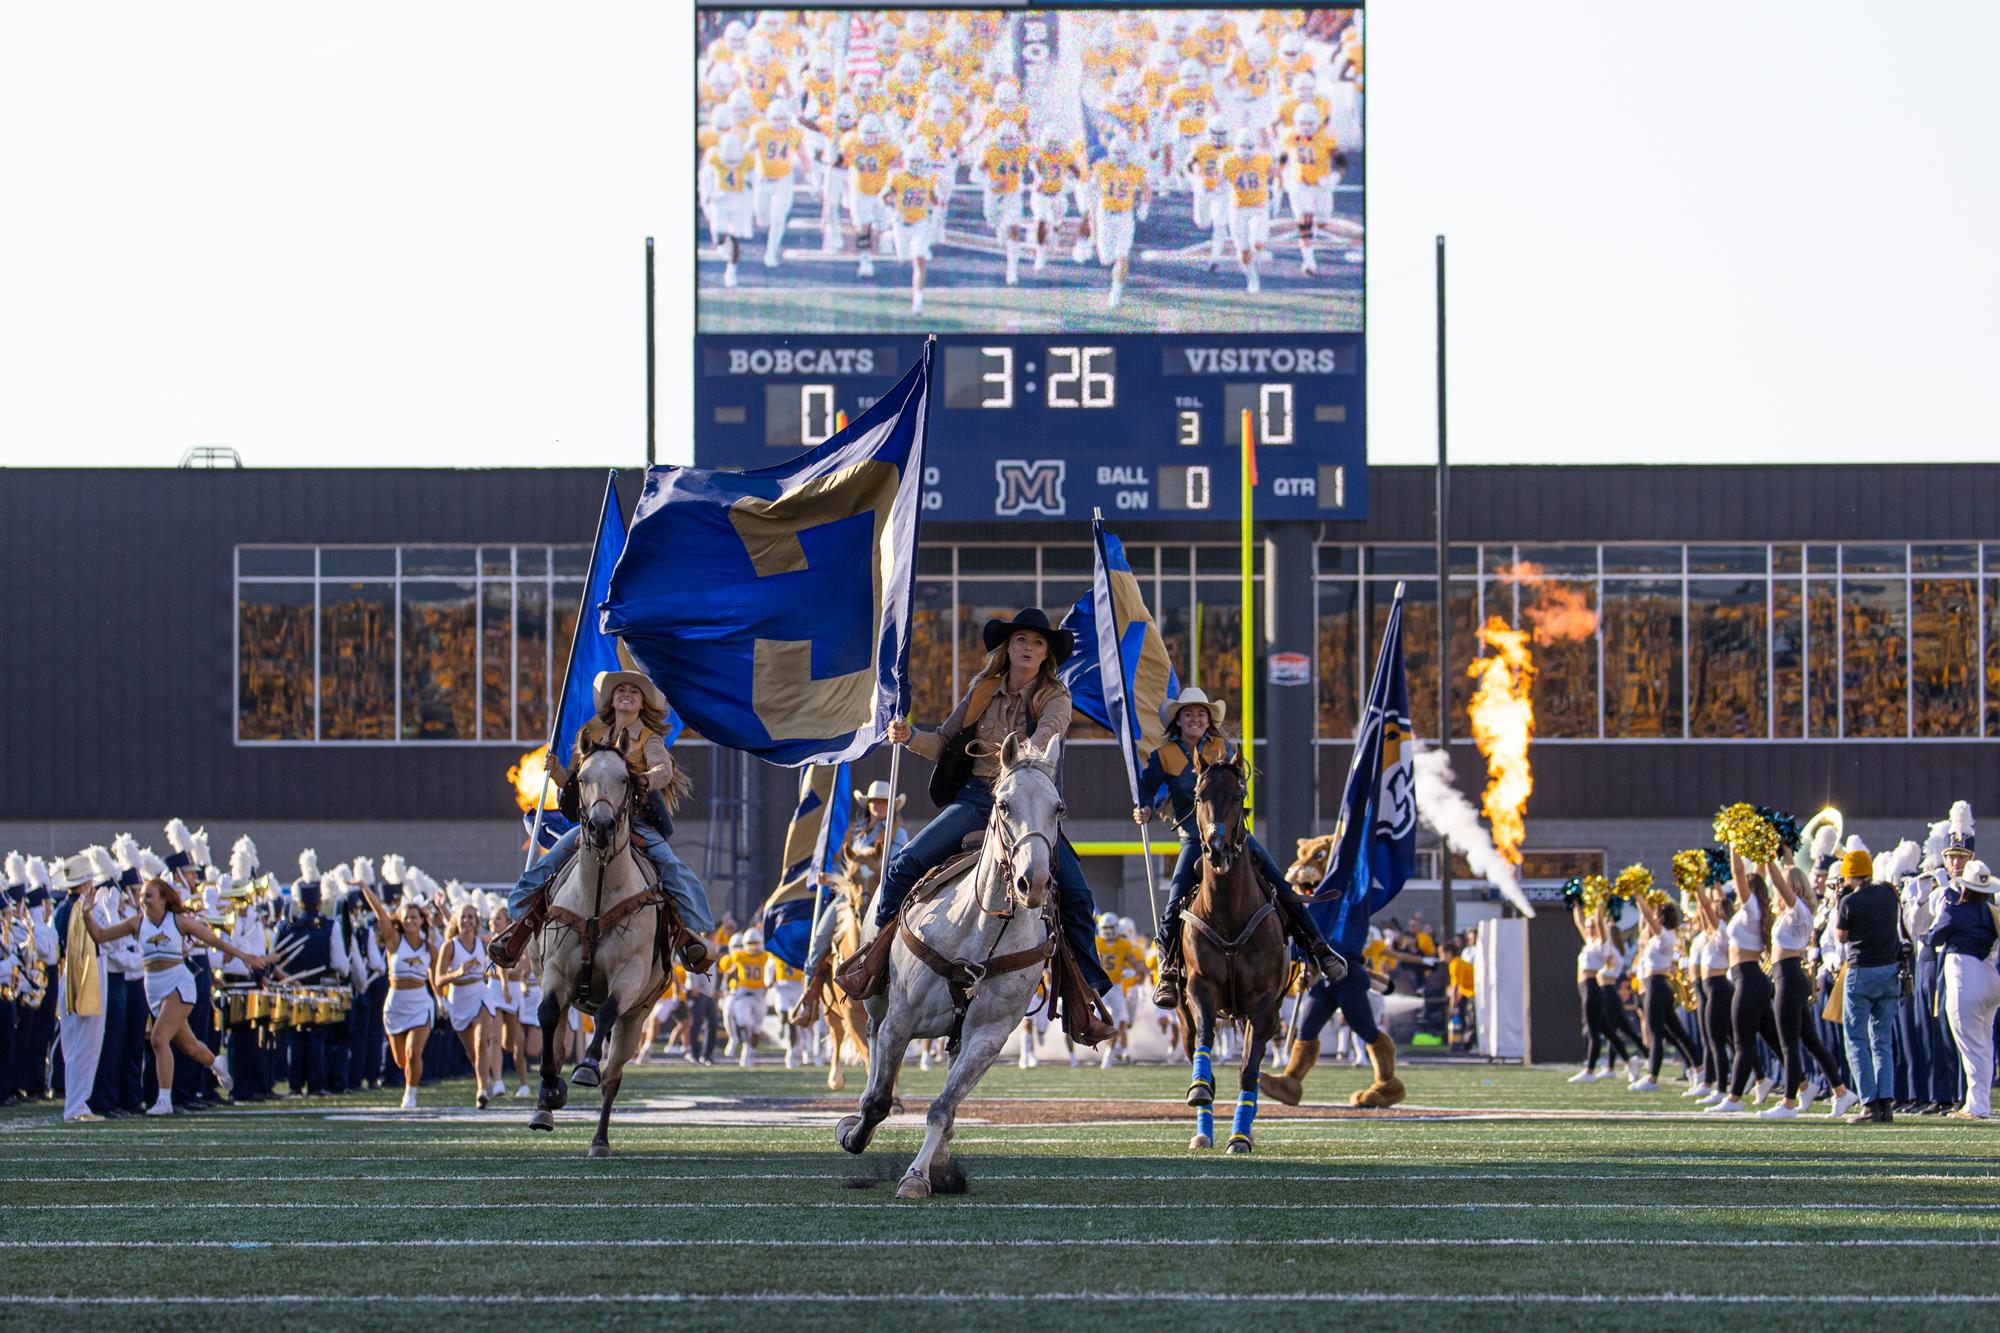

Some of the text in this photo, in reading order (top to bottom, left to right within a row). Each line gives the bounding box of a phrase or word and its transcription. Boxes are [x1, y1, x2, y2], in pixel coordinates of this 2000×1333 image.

[728, 348, 875, 374] BOBCATS
[1184, 348, 1336, 374] VISITORS
[801, 384, 835, 446] 0
[1180, 411, 1200, 446] 3
[1260, 384, 1293, 445] 0
[995, 459, 1066, 516] M
[1097, 466, 1149, 485] BALL
[1186, 466, 1210, 510] 0
[1273, 478, 1316, 496] QTR
[1334, 466, 1344, 508] 1
[1116, 491, 1148, 510] ON
